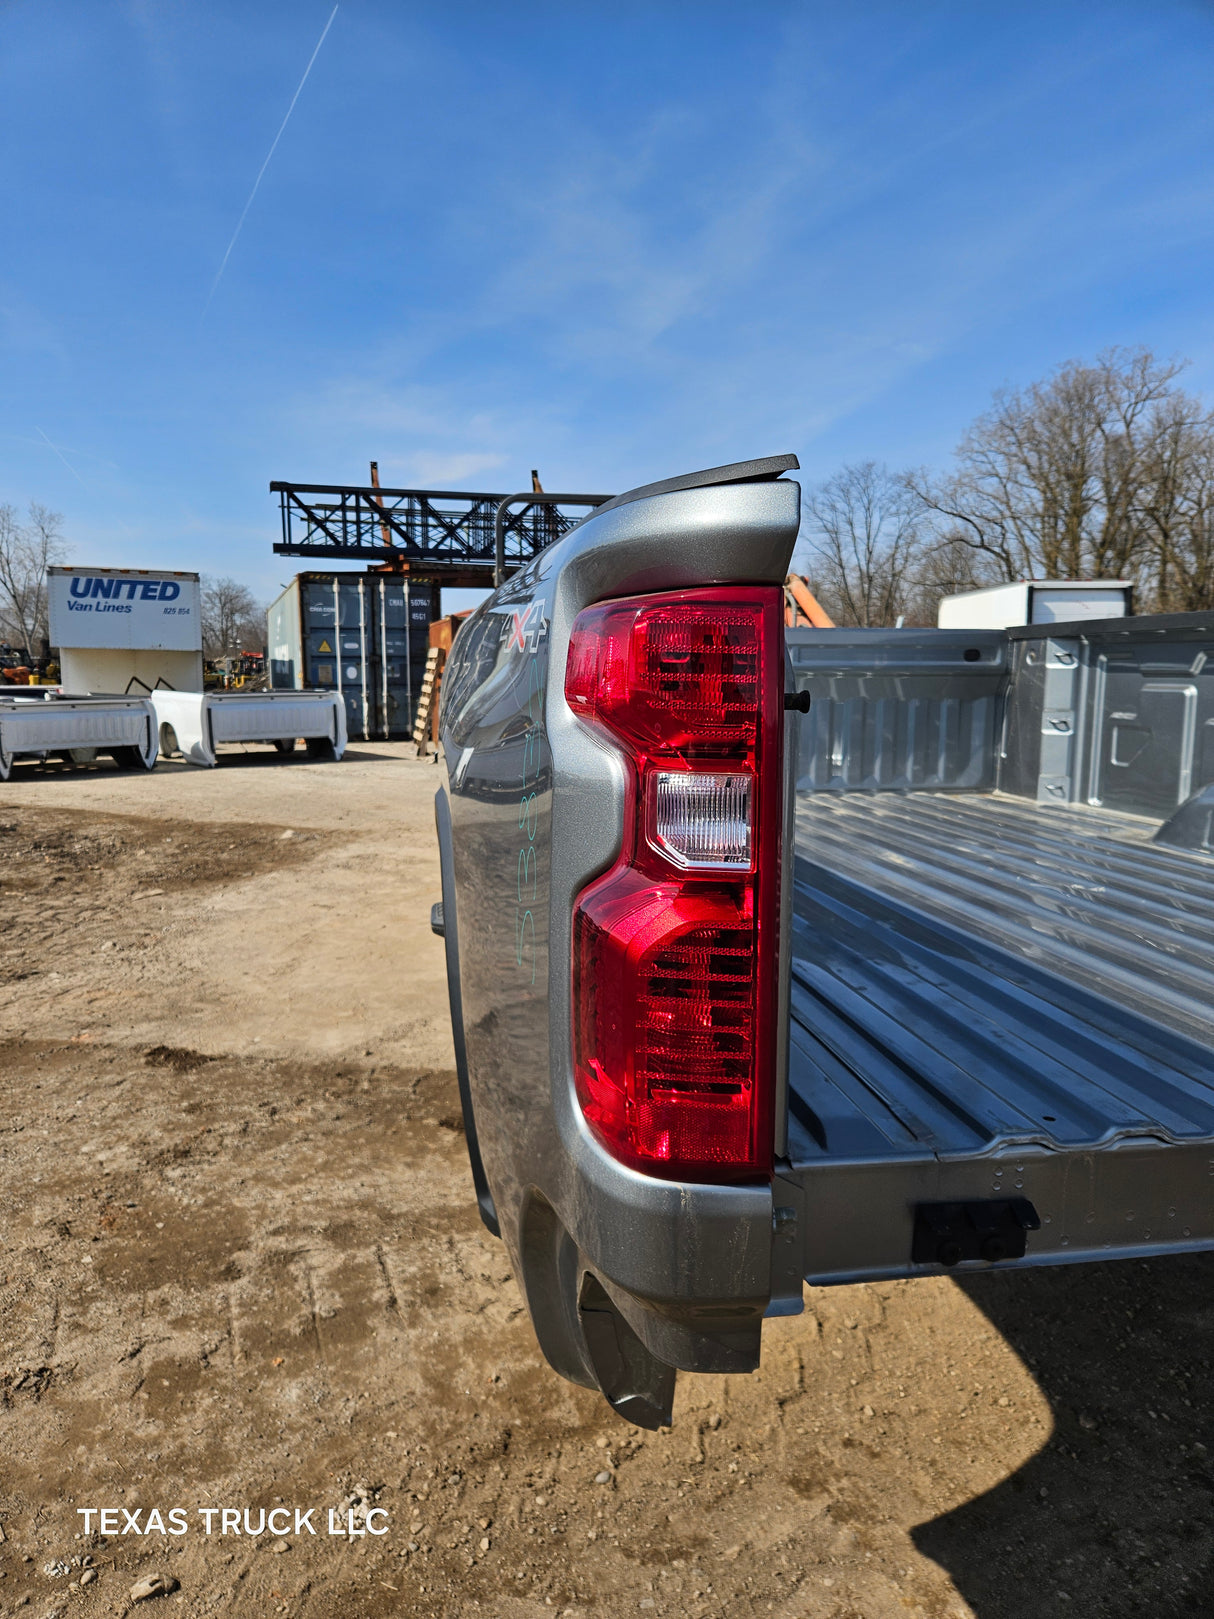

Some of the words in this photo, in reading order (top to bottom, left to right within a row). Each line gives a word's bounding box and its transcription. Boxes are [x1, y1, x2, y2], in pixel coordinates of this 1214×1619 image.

[70, 577, 180, 601] UNITED
[67, 600, 92, 612] Van
[95, 601, 132, 613] Lines
